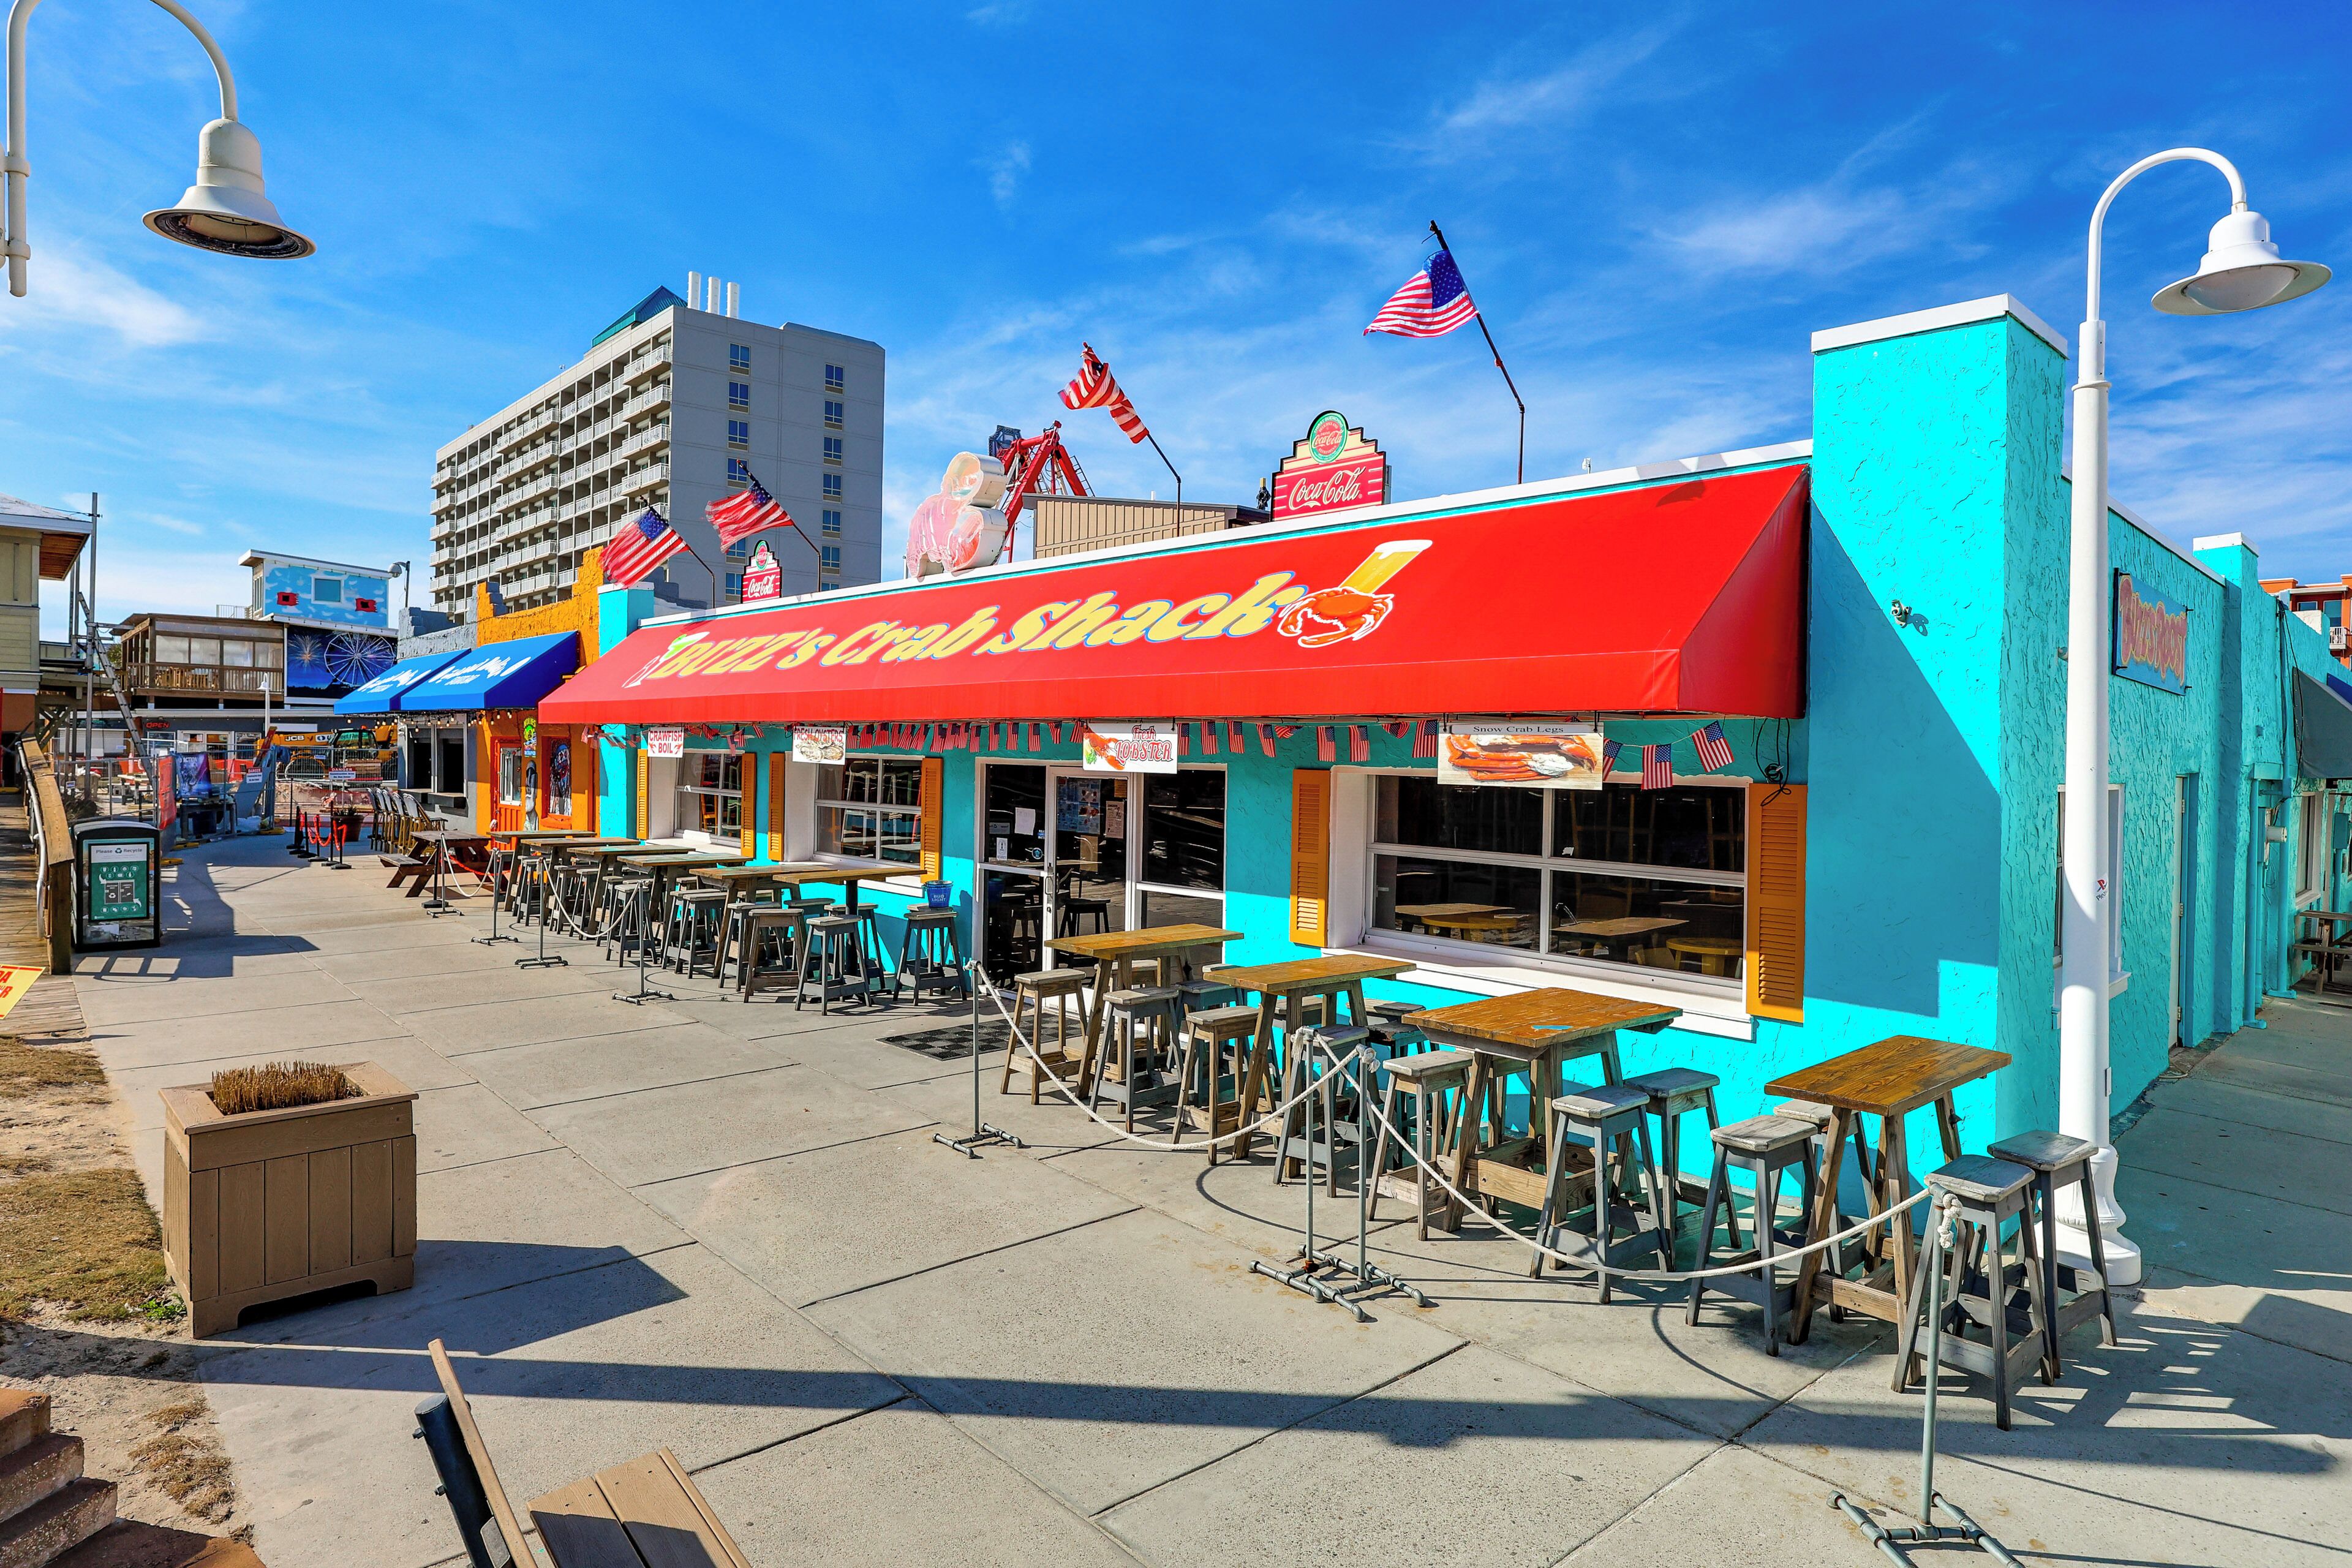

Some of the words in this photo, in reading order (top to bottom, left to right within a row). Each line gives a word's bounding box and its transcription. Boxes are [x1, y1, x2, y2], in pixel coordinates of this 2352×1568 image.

[1289, 466, 1366, 510] Coca-Cola
[748, 575, 776, 598] Coca-Cola
[820, 605, 1000, 666] Crab
[973, 571, 1308, 655] Shack
[2154, 600, 2188, 687] ROOST
[649, 730, 682, 742] CRAWFISH
[794, 728, 813, 741] FRESH
[815, 729, 843, 743] OYSTERS
[1132, 725, 1156, 741] Fresh
[658, 742, 673, 754] BOIL
[1115, 739, 1174, 766] LOBSTER
